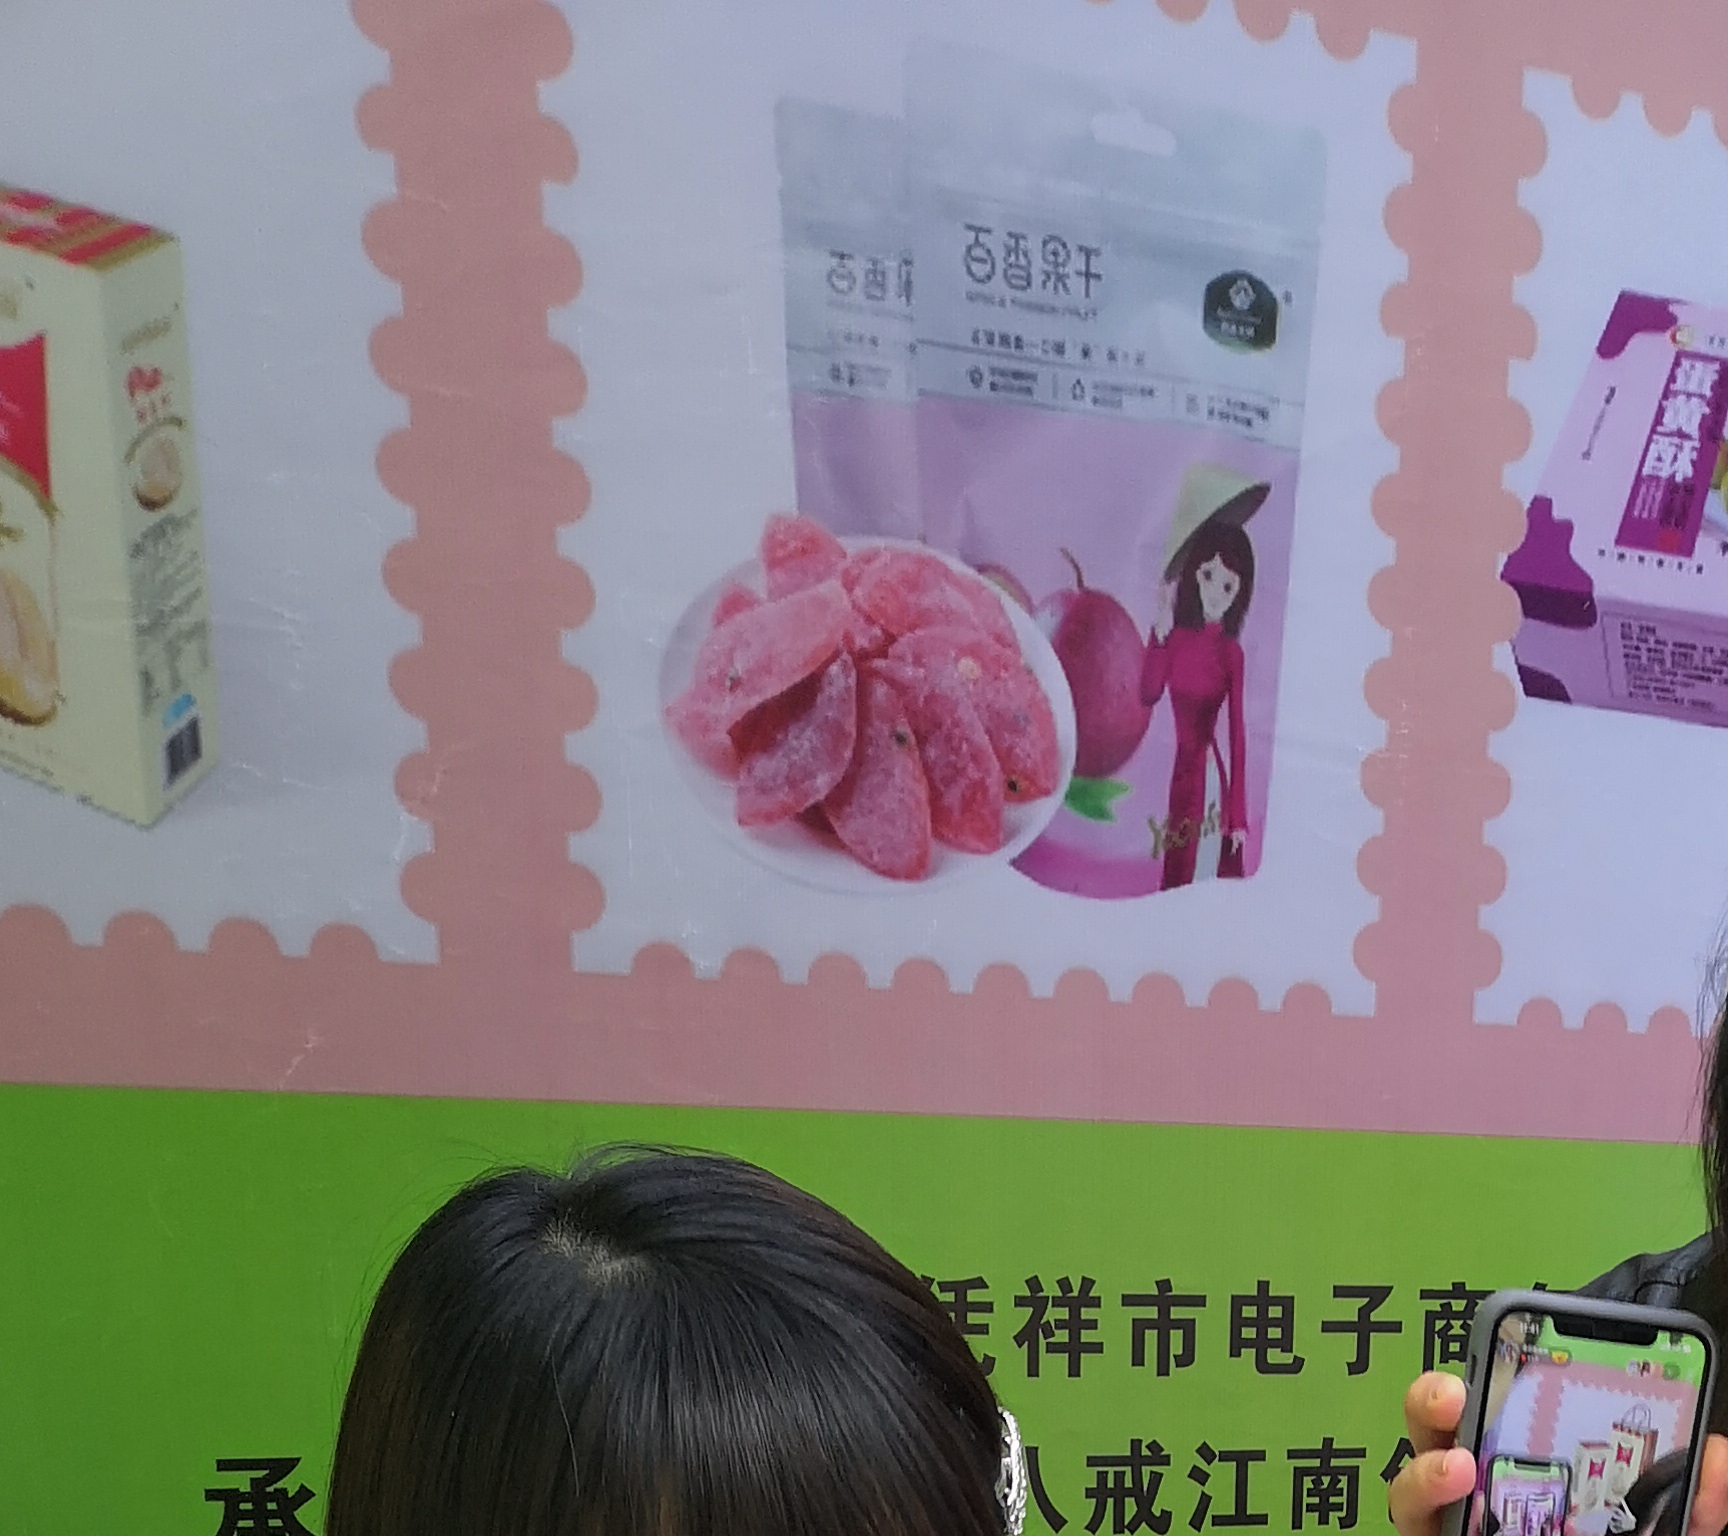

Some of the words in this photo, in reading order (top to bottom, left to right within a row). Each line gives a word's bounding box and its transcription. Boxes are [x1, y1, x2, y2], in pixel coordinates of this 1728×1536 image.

[964, 223, 1103, 300] 百香果干
[920, 1273, 1500, 1379] 凭祥市电子商
